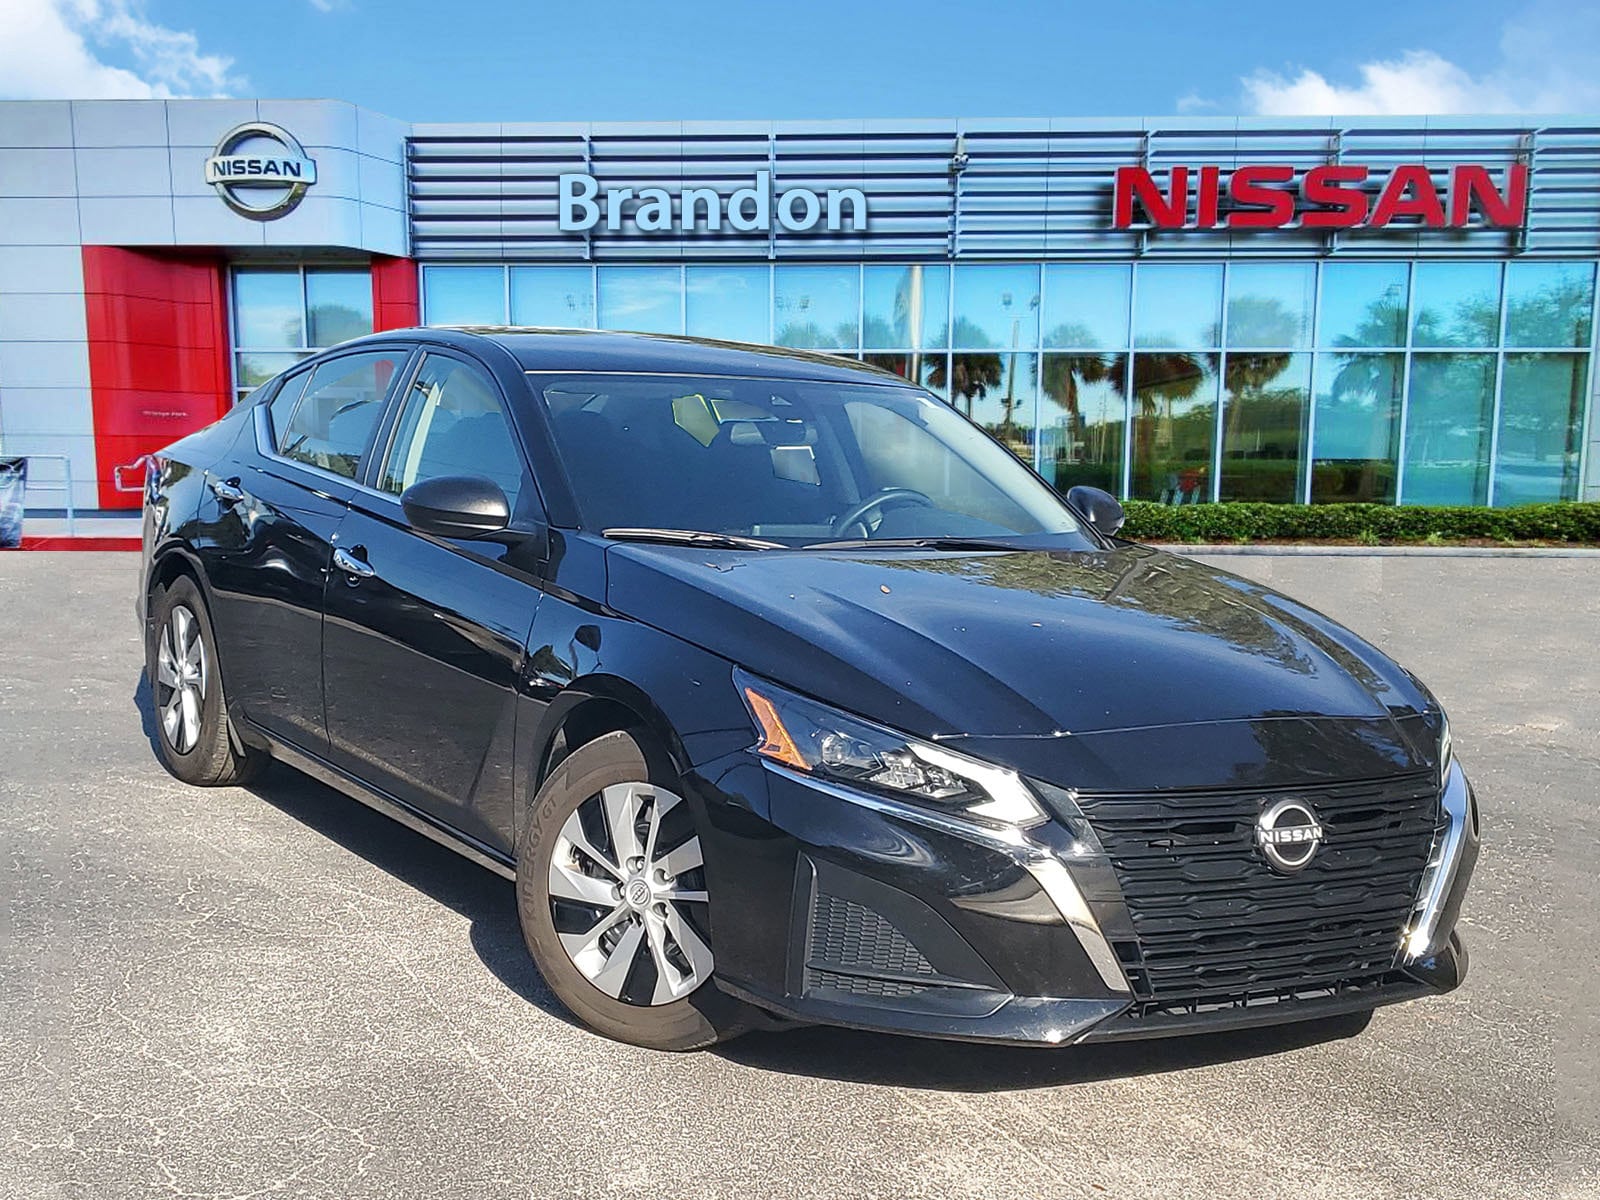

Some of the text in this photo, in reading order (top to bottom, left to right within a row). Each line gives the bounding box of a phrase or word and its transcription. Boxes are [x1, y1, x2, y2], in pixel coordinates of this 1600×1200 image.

[213, 160, 301, 177] NISSAN
[559, 171, 867, 231] Brandon
[1113, 165, 1527, 229] NISSAN
[1260, 827, 1323, 843] NISSAN
